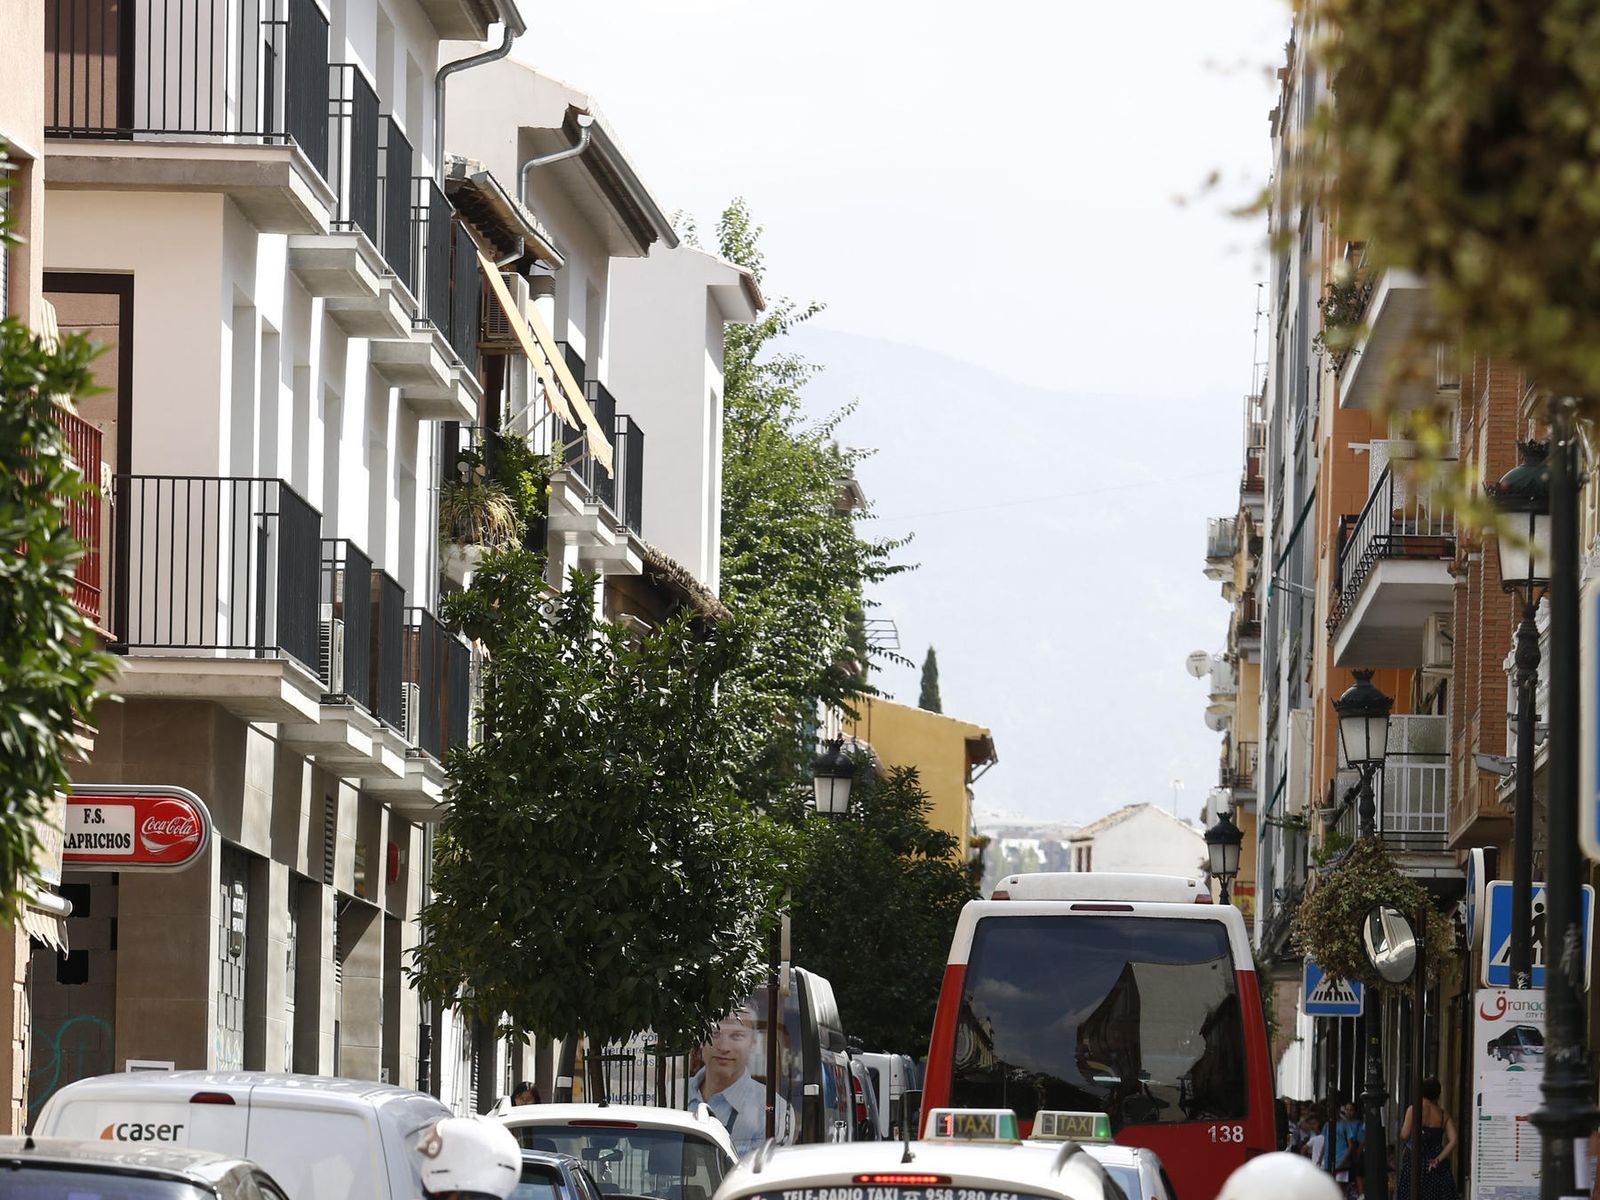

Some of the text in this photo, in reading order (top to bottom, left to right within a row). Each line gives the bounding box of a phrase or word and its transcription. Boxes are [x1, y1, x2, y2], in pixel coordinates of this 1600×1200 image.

[83, 808, 105, 824] F.S.
[141, 816, 195, 835] Coca-Cola
[116, 1123, 184, 1141] caser
[957, 1115, 994, 1133] TAXI
[1058, 1116, 1092, 1132] TAXI
[1208, 1125, 1244, 1143] 138
